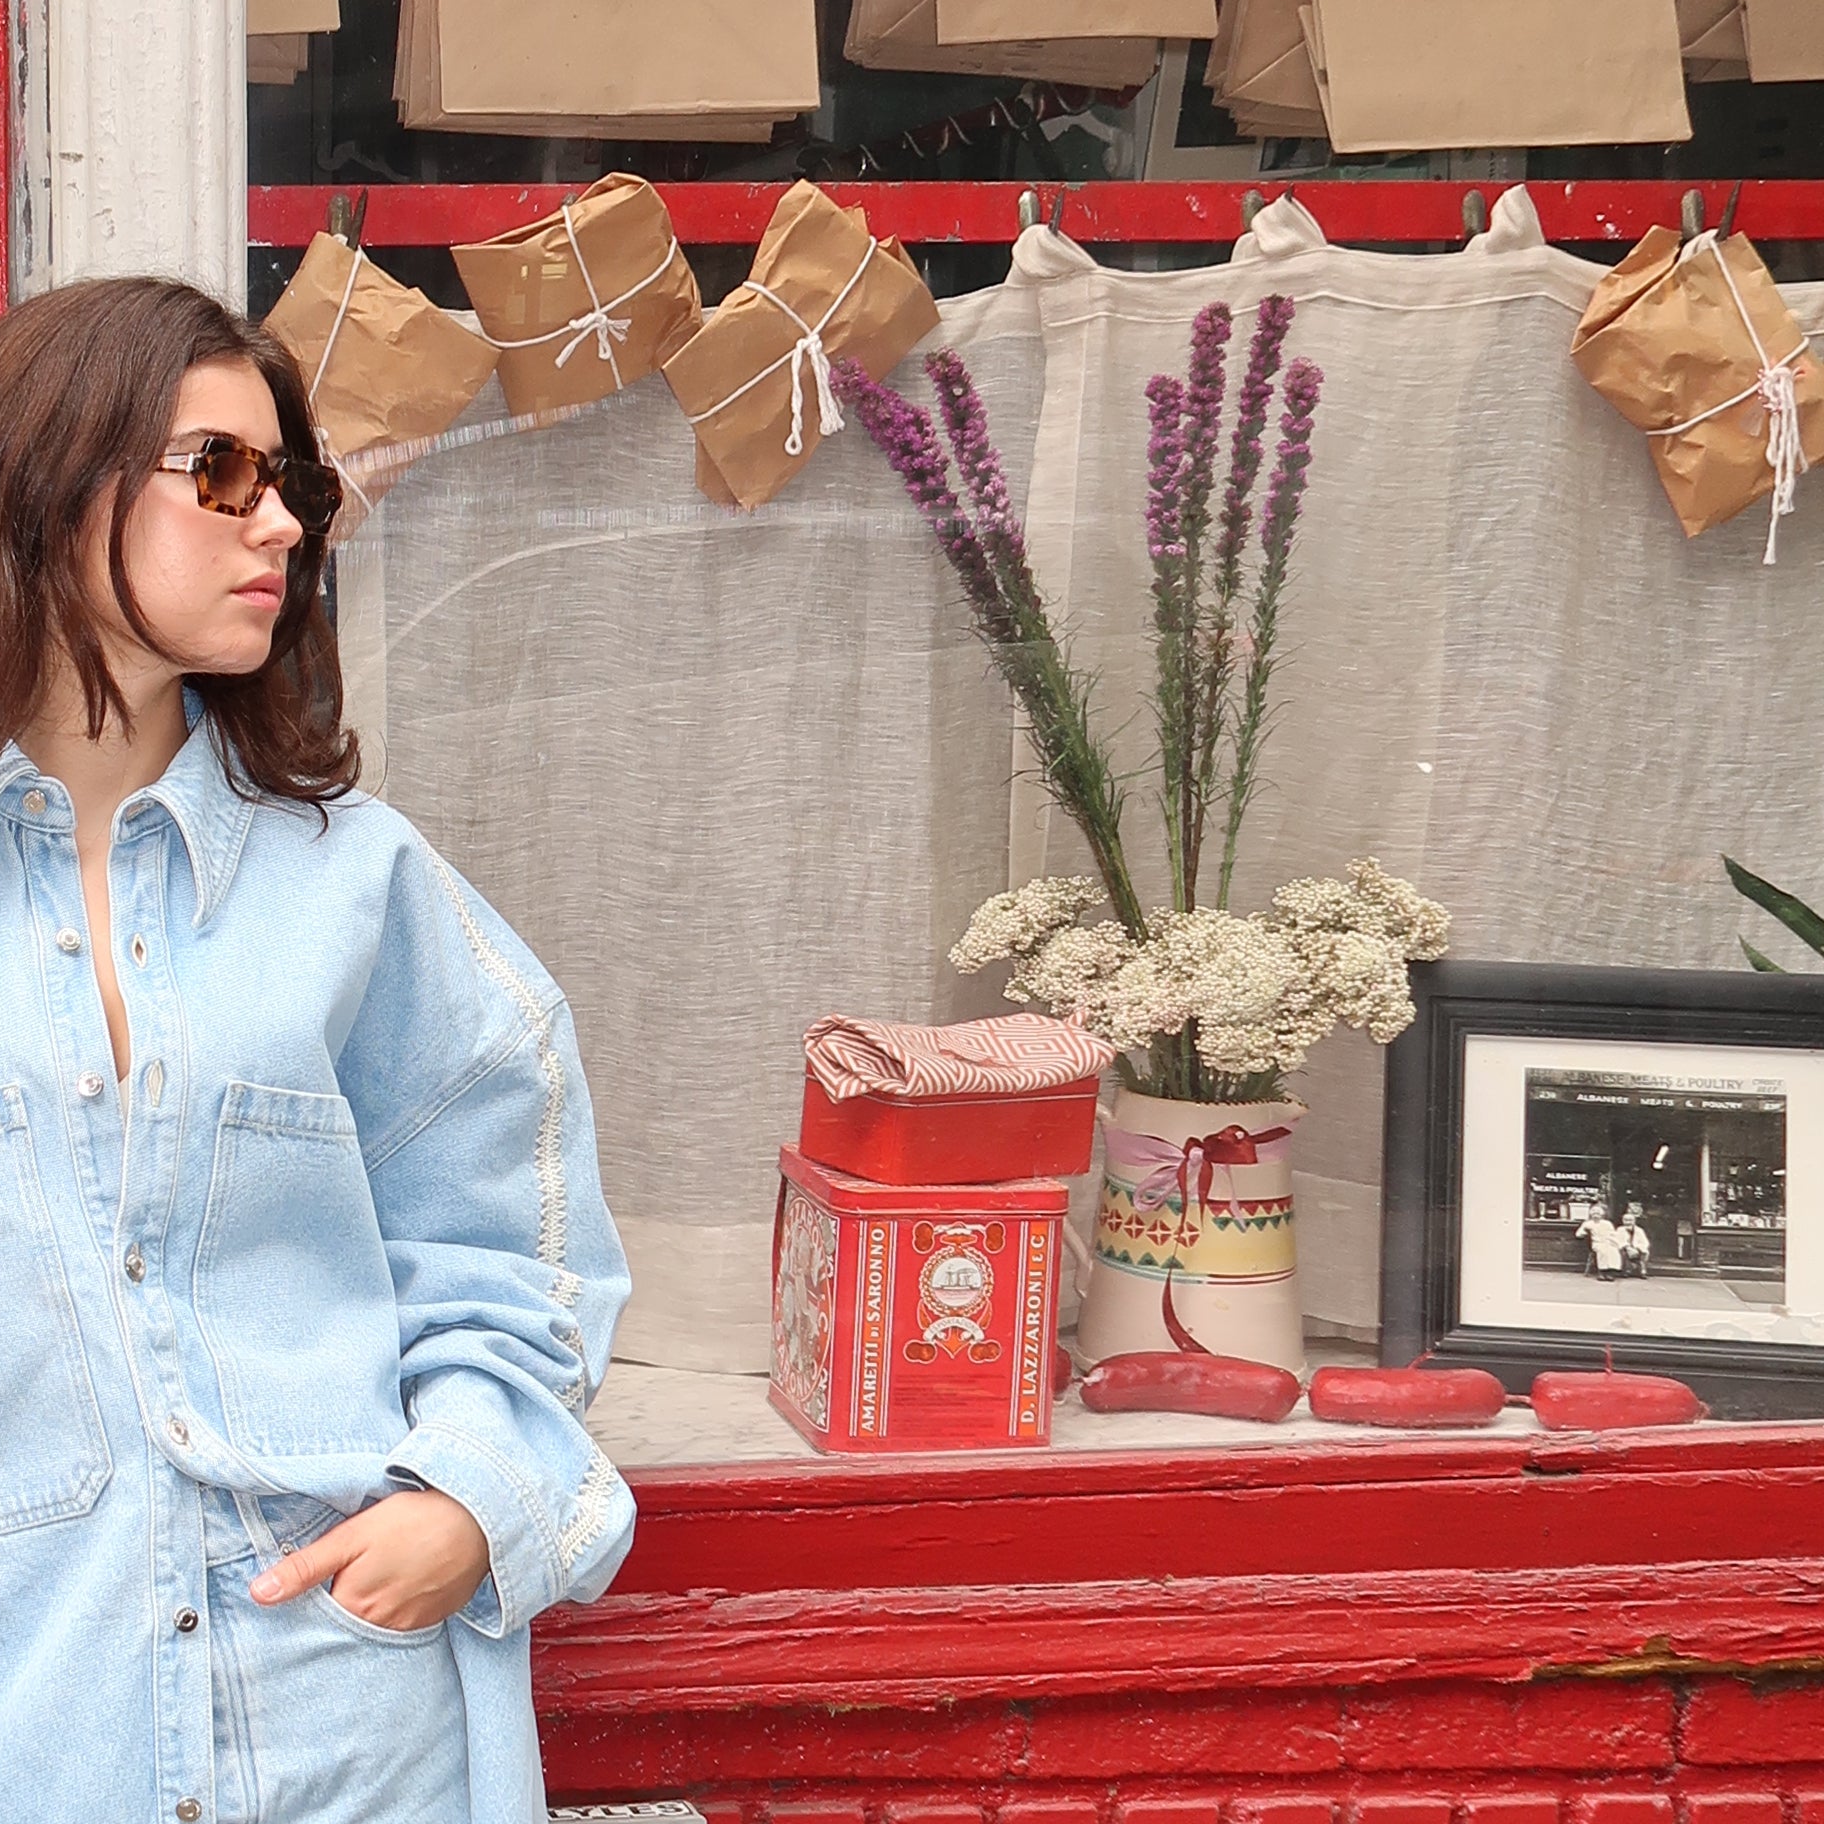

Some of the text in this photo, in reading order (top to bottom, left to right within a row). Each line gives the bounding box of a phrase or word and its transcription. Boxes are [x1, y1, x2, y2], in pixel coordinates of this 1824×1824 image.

[1577, 1093, 1629, 1104] ALBANESE
[1688, 1078, 1744, 1090] POULTRY
[866, 1228, 887, 1323] SARONNO
[1022, 1270, 1044, 1396] LAZZARONI
[861, 1343, 878, 1432] AMARETTI
[1020, 1402, 1038, 1424] D.
